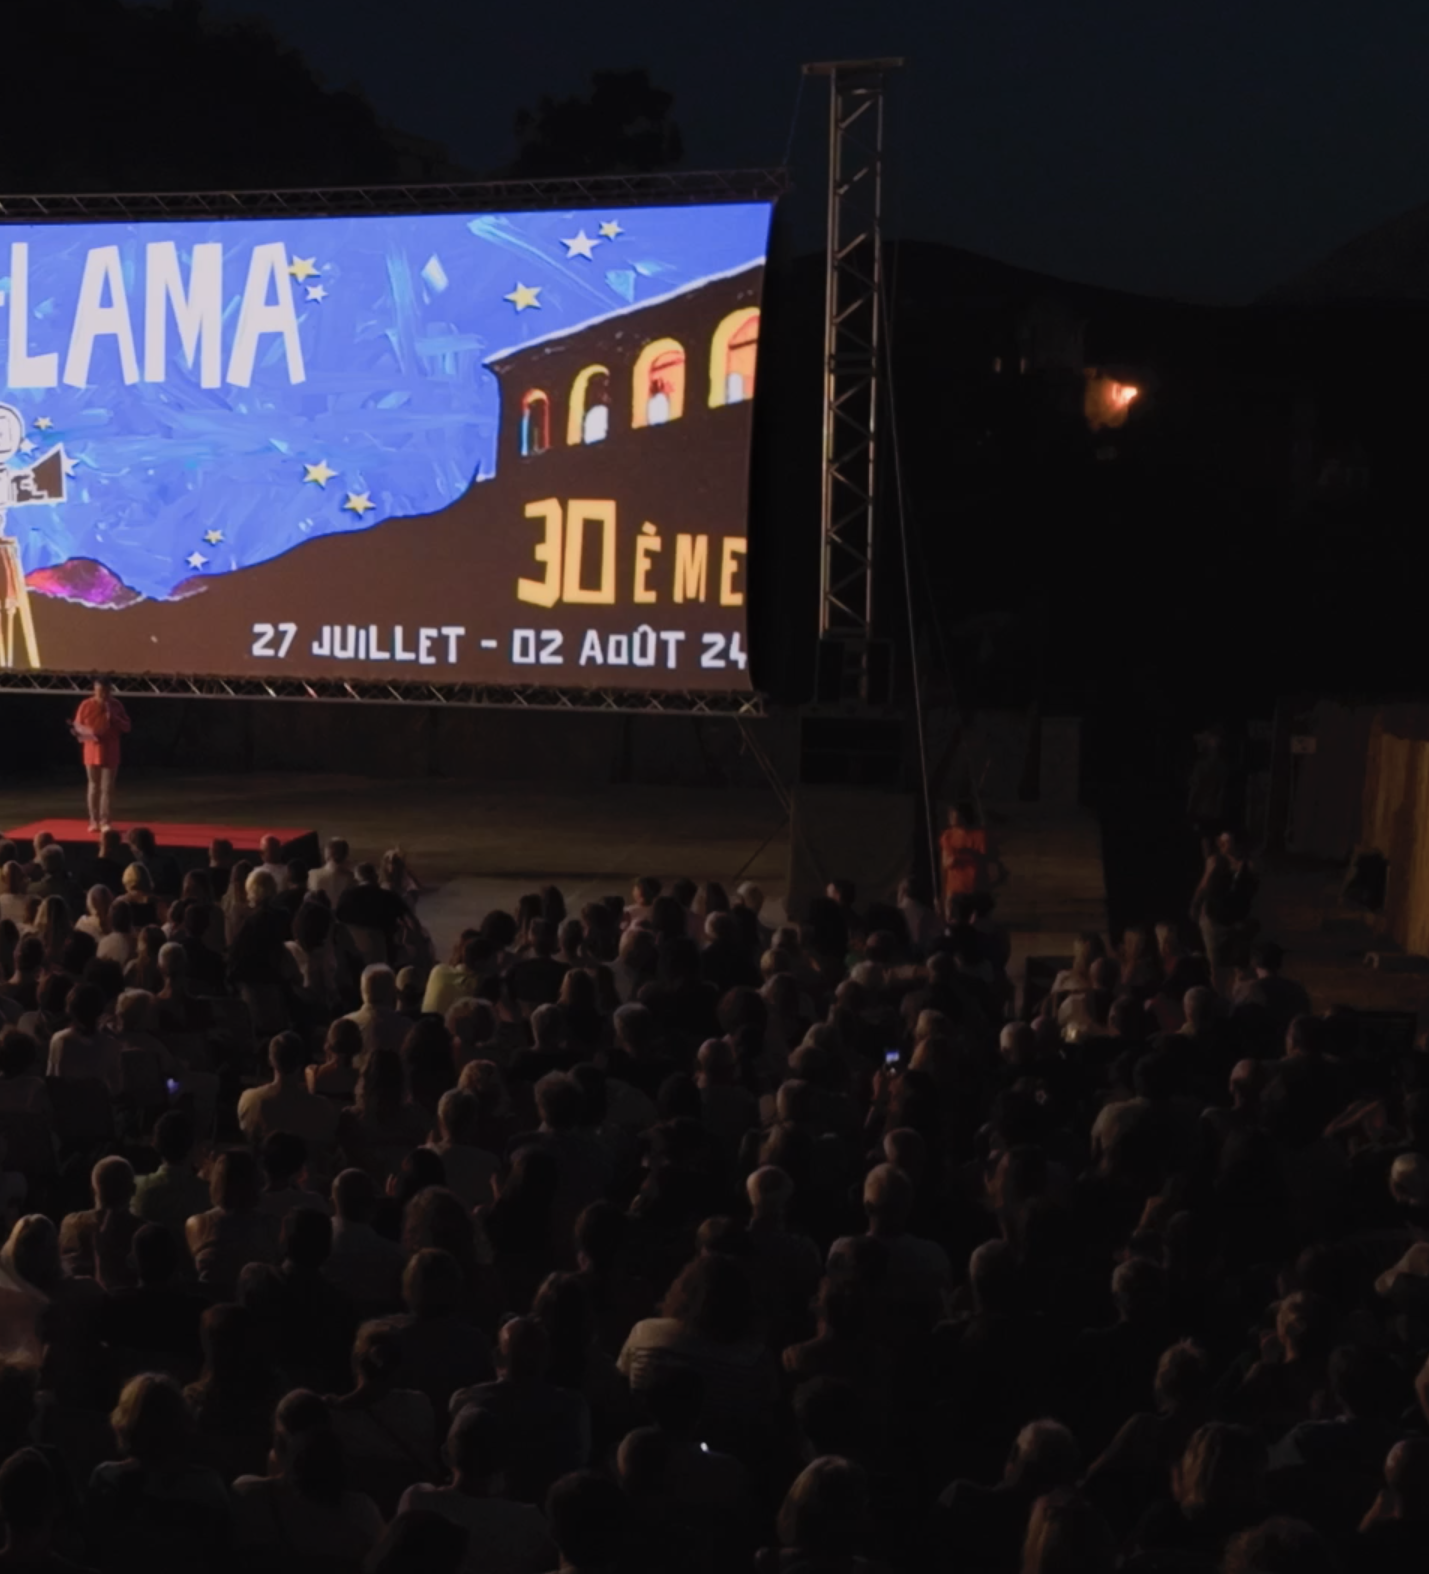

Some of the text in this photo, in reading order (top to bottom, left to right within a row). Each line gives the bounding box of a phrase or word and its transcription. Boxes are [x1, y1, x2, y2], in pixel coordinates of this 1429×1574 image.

[7, 241, 307, 389] LAMA
[252, 623, 298, 659] 27
[312, 625, 466, 665] JUILLET
[512, 629, 564, 664] 02
[701, 632, 747, 669] 24
